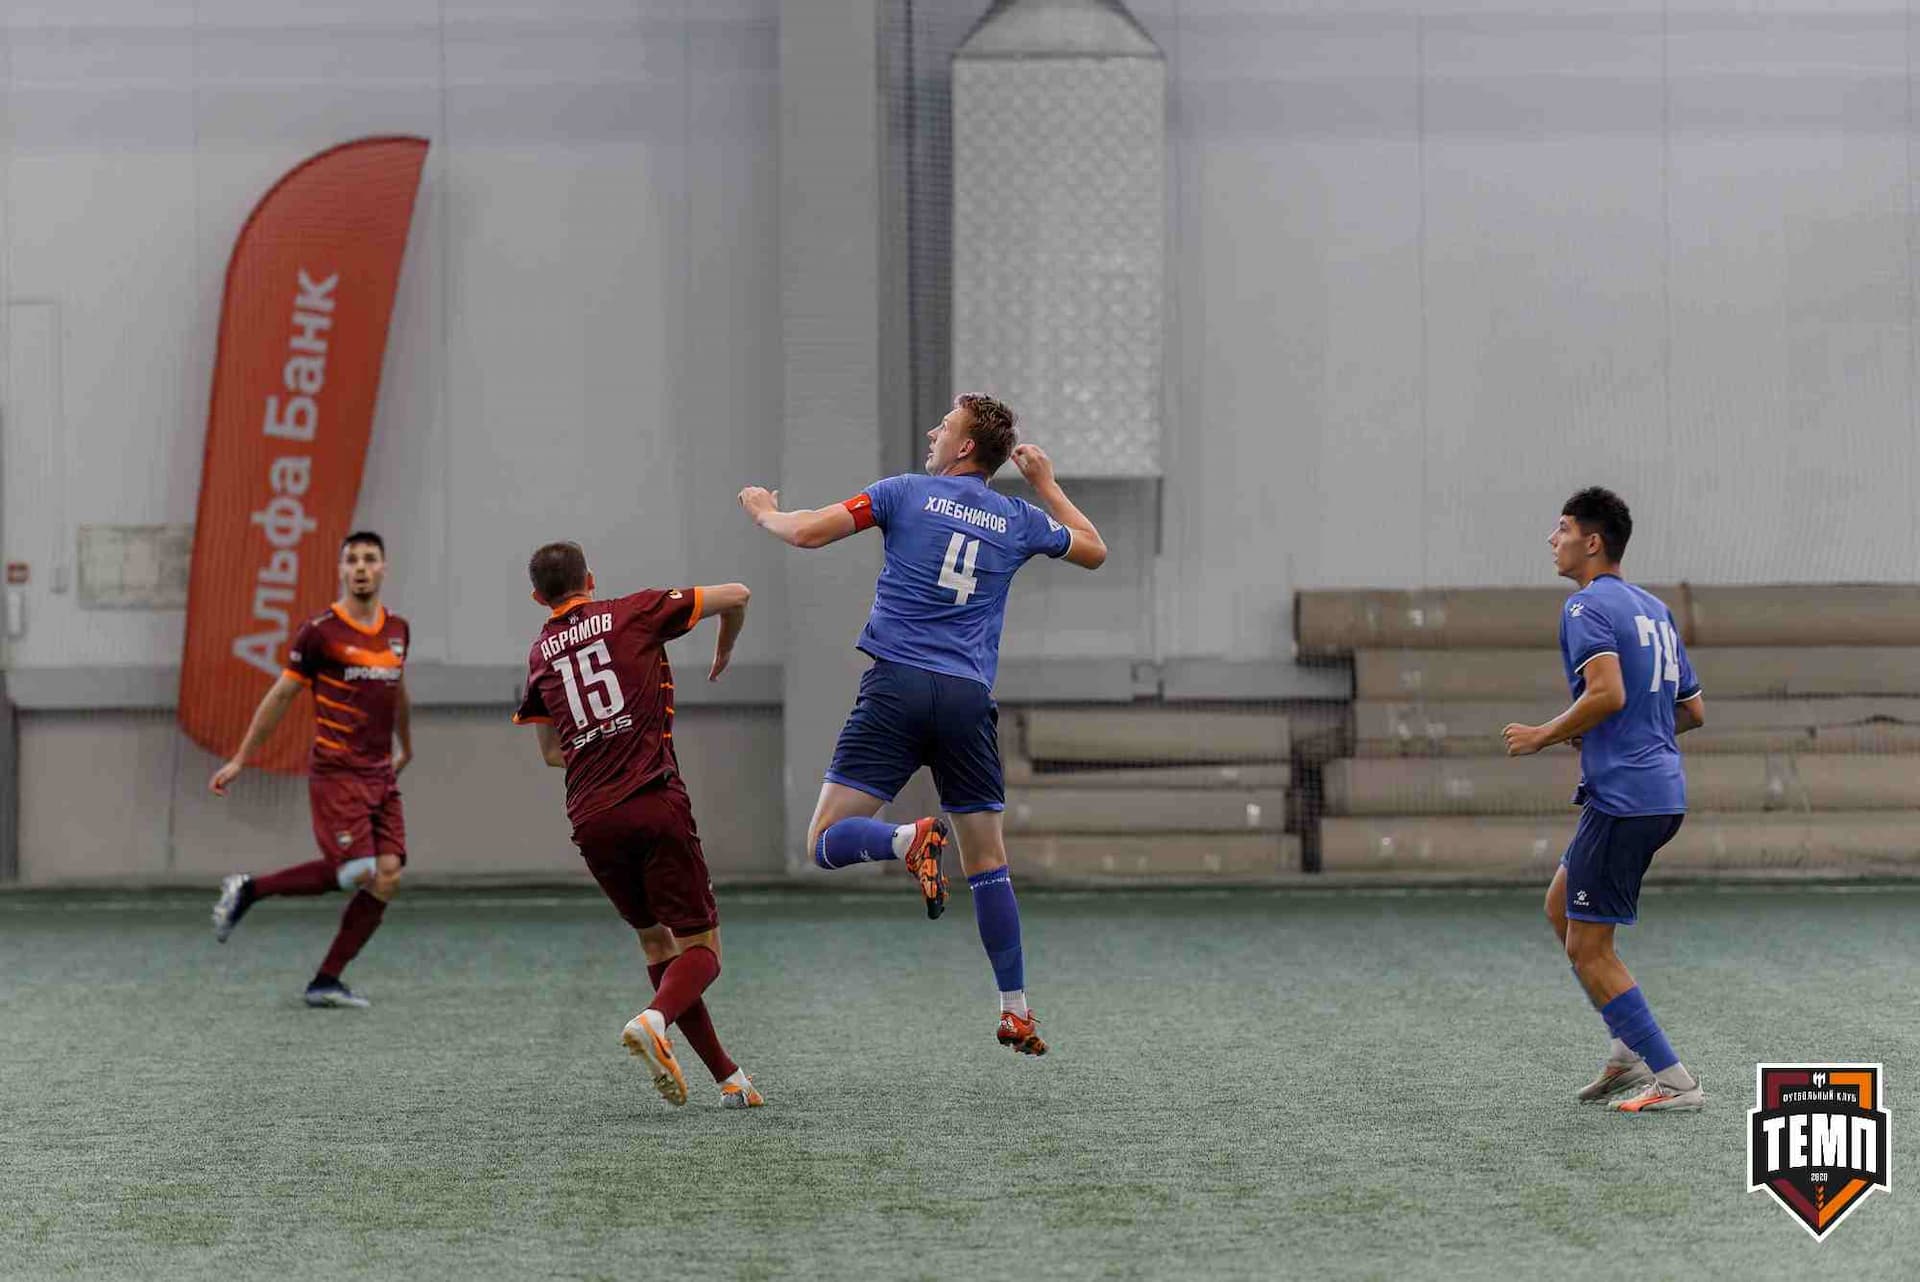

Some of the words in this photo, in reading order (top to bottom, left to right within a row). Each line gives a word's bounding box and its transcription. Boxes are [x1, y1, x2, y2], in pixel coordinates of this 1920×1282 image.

[263, 270, 338, 441] Банк
[924, 496, 1007, 533] ХЛЕБНИКОВ
[232, 455, 317, 678] Альфа
[938, 532, 980, 605] 4
[540, 613, 612, 661] АБРАМОВ
[1634, 615, 1680, 699] 74
[552, 638, 625, 730] 15
